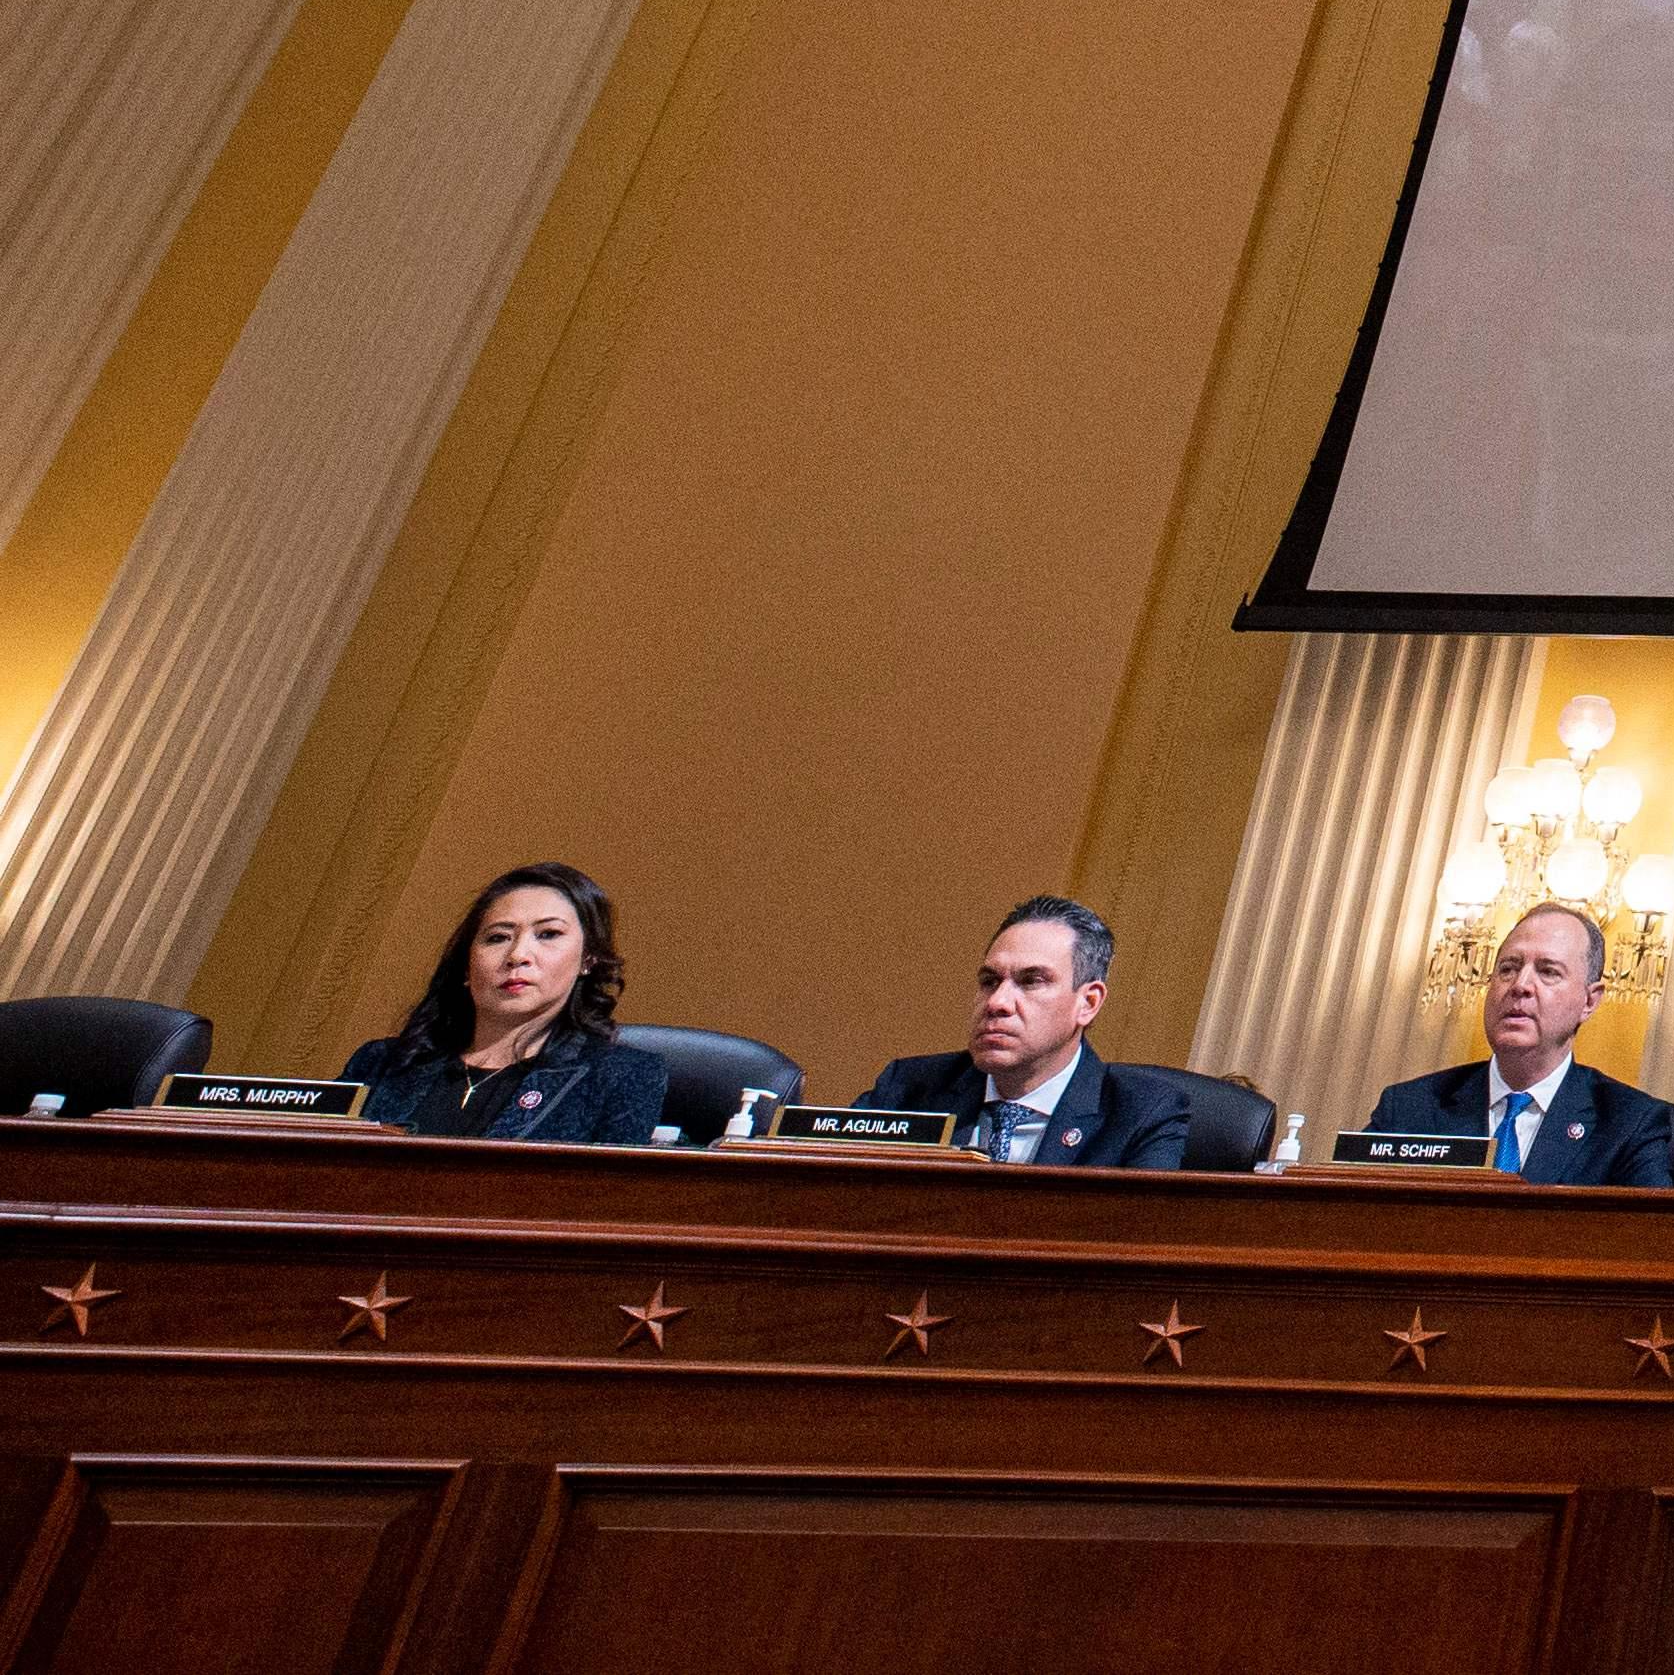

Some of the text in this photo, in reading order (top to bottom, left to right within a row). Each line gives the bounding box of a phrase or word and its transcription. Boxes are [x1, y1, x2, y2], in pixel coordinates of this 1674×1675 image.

[199, 1086, 322, 1105] MRS. MURPHY
[813, 1117, 909, 1135] MR. AGUILAR
[1370, 1143, 1450, 1159] MR. SCHIFF
